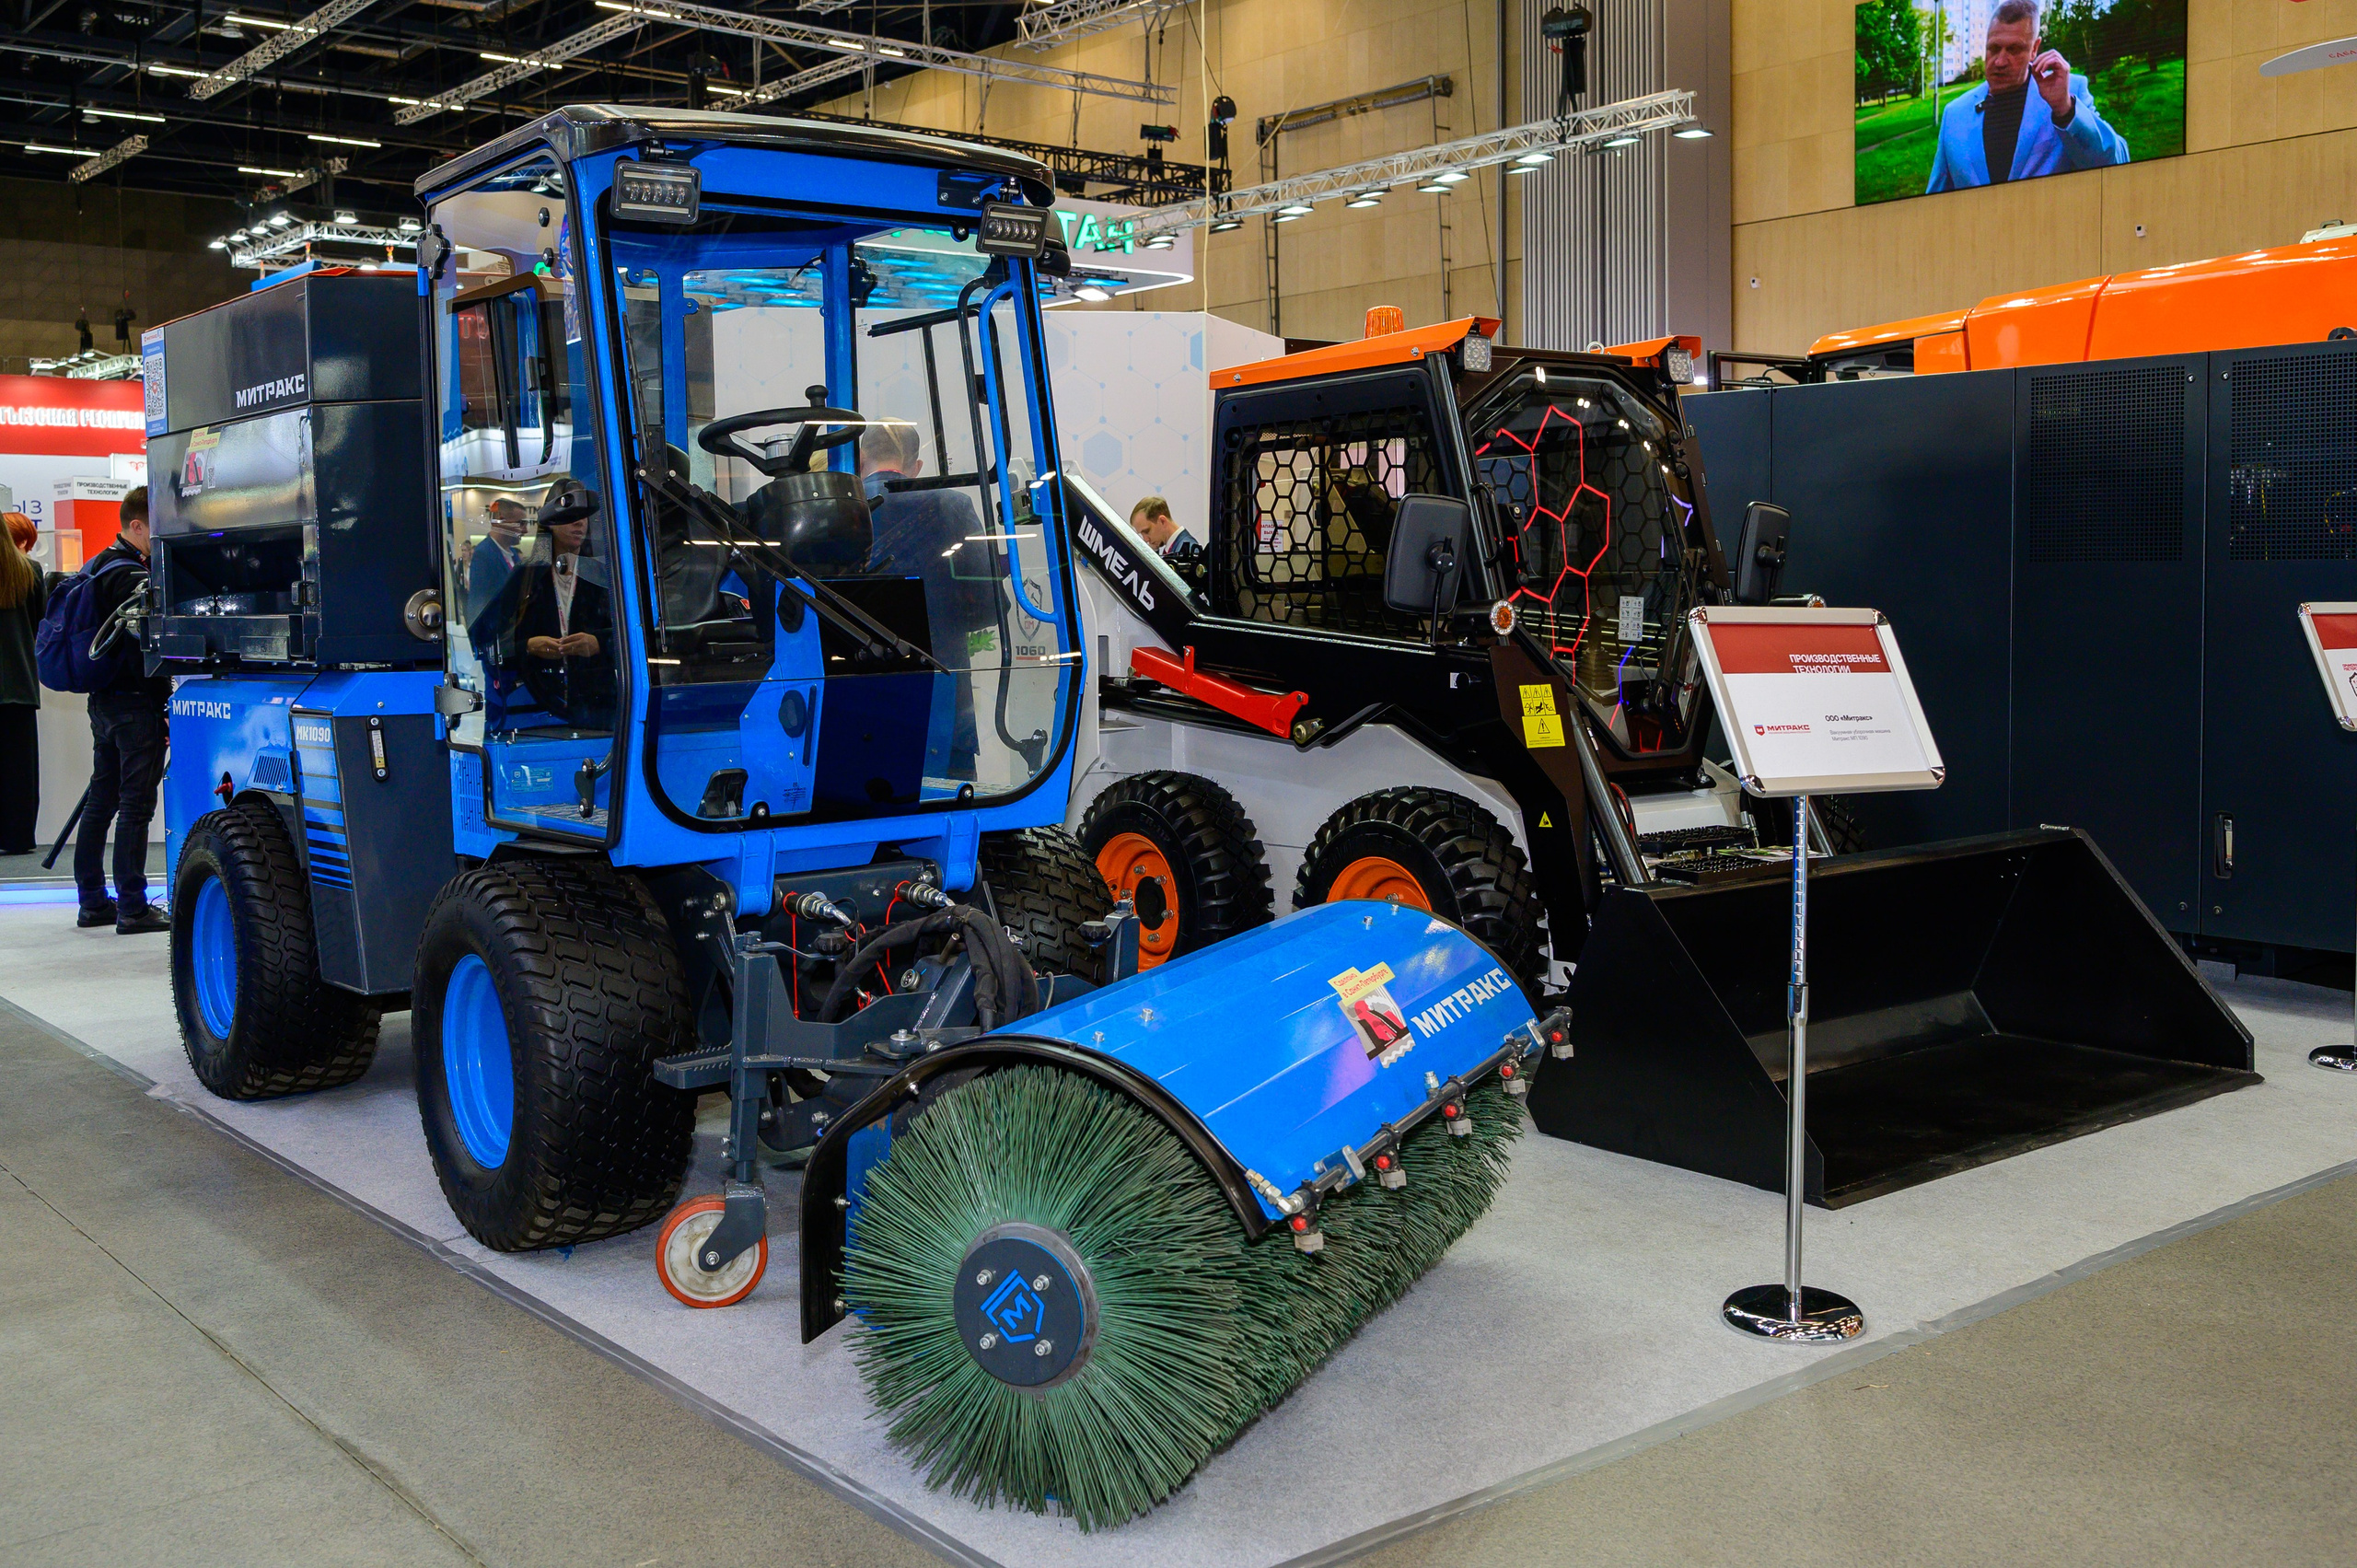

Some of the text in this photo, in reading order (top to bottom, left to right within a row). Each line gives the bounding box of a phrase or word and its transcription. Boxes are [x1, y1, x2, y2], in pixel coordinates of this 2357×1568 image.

[1056, 210, 1133, 254] ТАН
[236, 373, 305, 409] МИТРАКС
[1077, 515, 1155, 611] ШМЕЛЬ
[1016, 646, 1046, 656] 1060
[1789, 654, 1881, 664] ПРОИЗВОДСТВЕННЫЕ
[1793, 665, 1852, 673] ТЕХНОЛОГИИ
[172, 700, 230, 719] МИТРАКС
[296, 725, 331, 743] МК1090
[1766, 724, 1810, 732] МИТРАКС
[1411, 968, 1512, 1038] МИТРАКС
